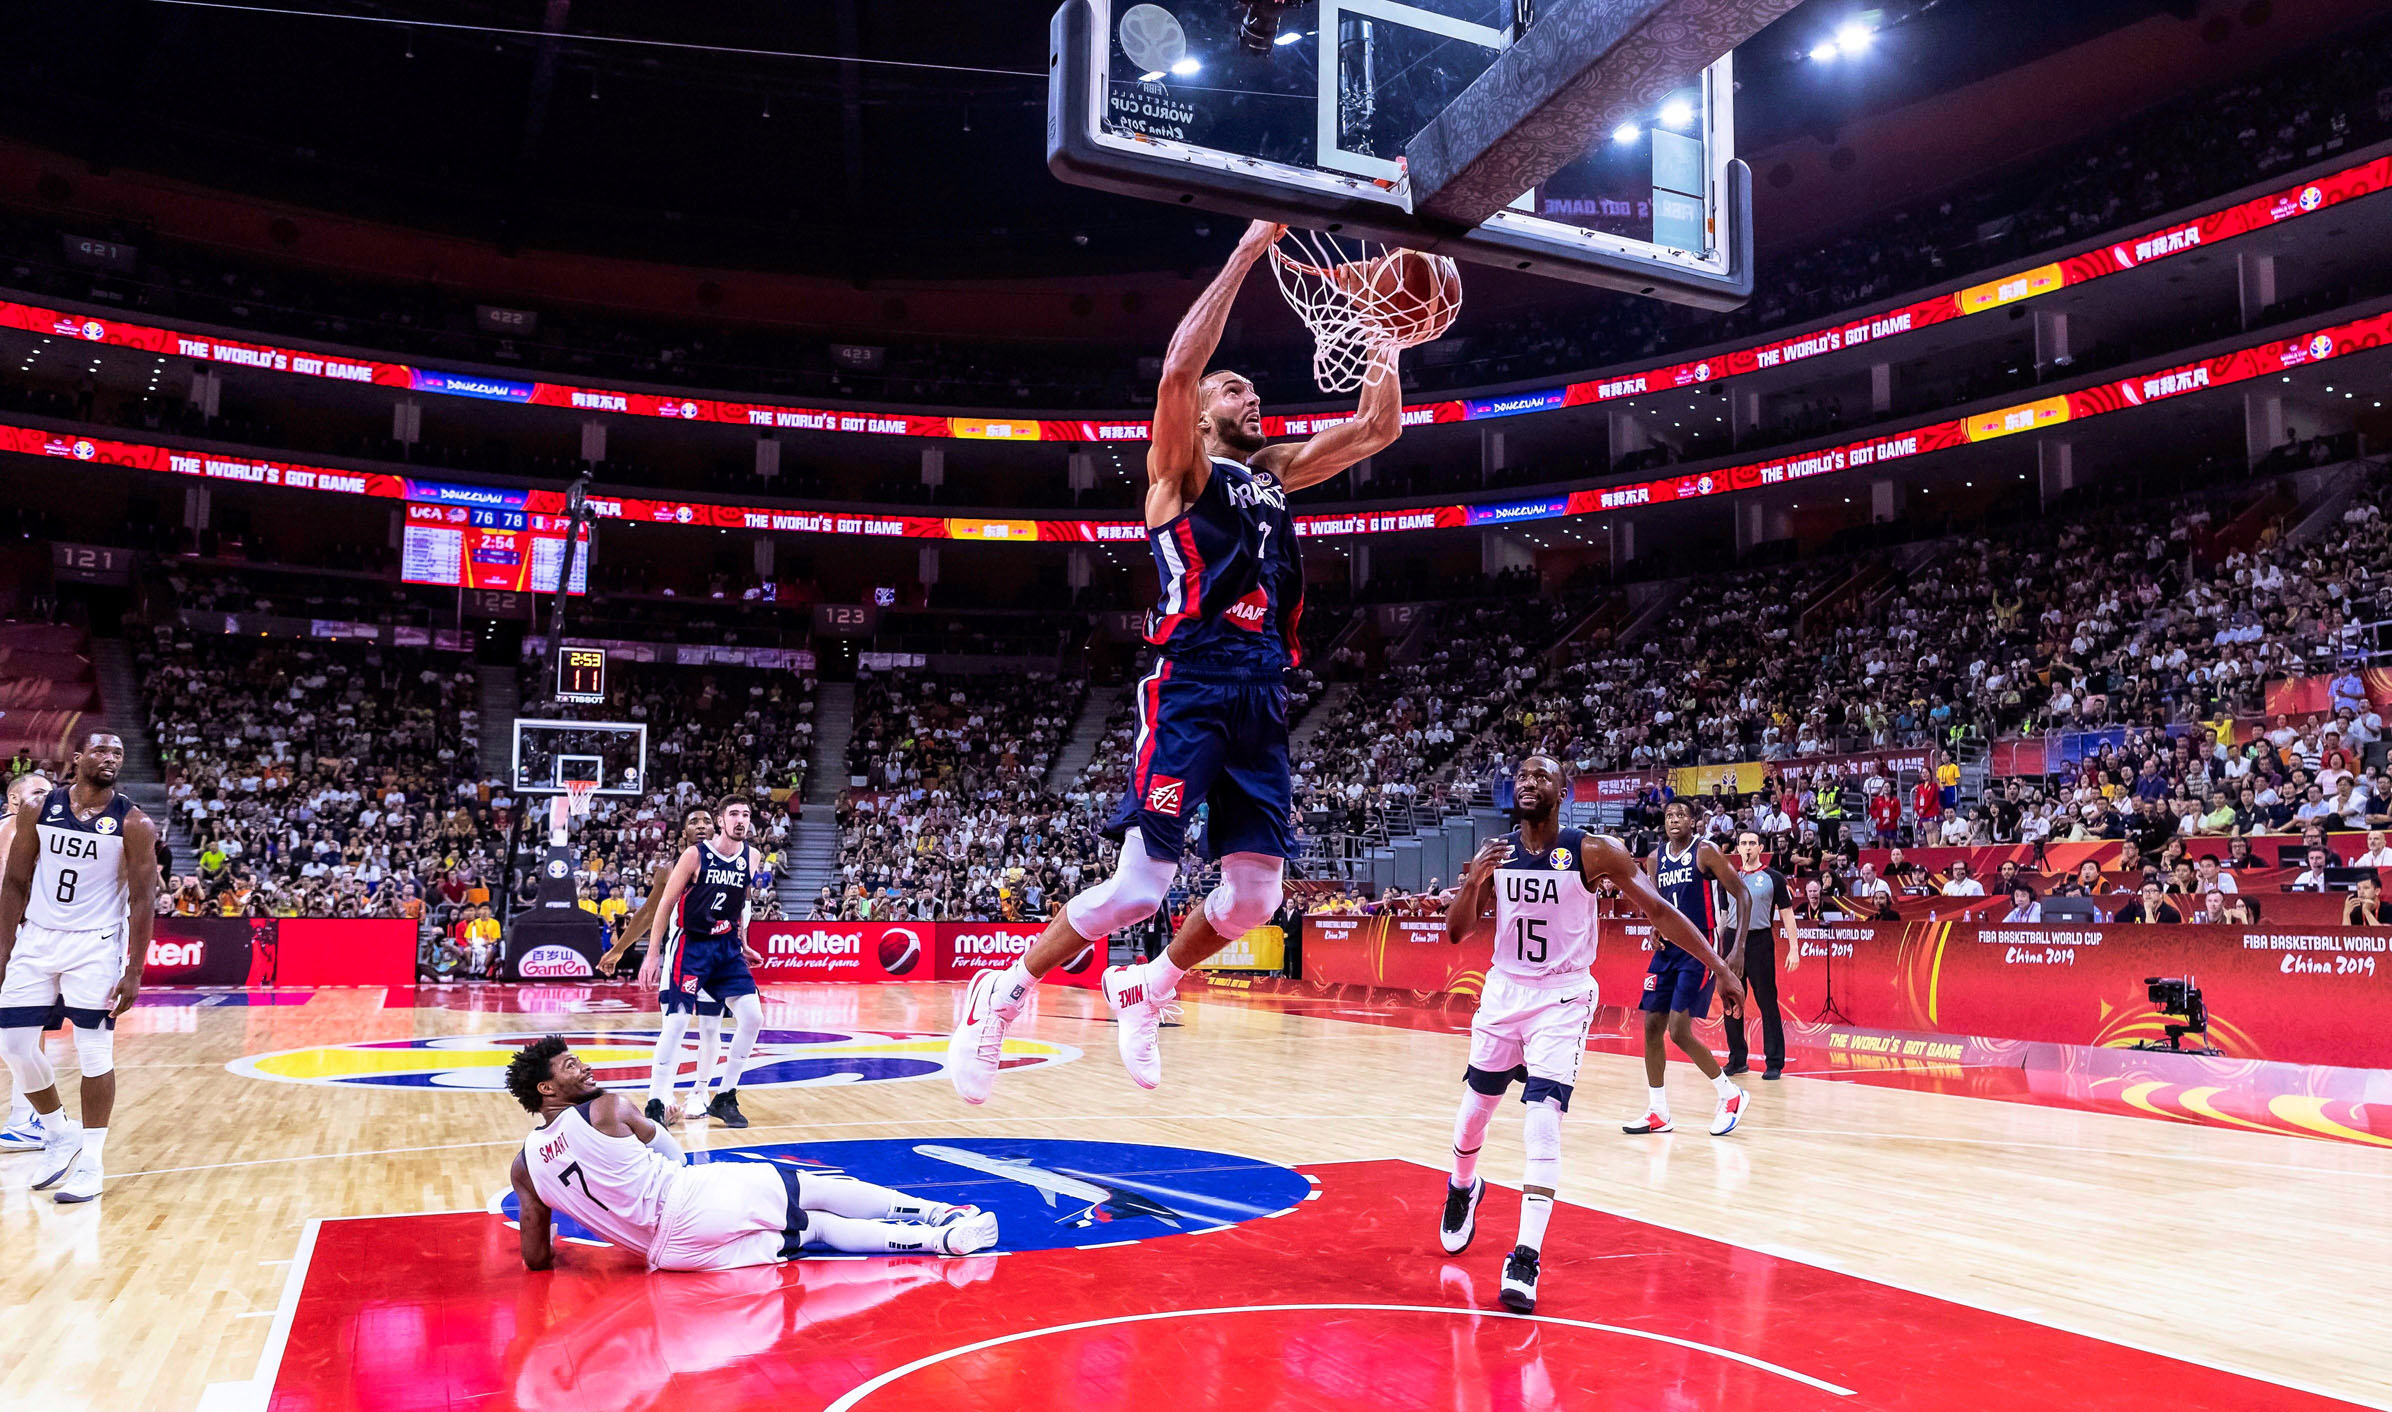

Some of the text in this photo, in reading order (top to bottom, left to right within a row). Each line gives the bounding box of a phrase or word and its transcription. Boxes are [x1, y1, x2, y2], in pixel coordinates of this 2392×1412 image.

[490, 311, 523, 324] 422
[1757, 313, 1911, 368] THE WORLD'S GOT GAME
[178, 339, 373, 382] THE WORLD'S GOT GAME
[842, 349, 871, 360] 423
[748, 410, 906, 434] THE WORLD'S GOT GAME
[1284, 421, 1308, 434] THE
[1760, 437, 1917, 484] THE WORLD'S GOT GAME
[169, 456, 366, 493] THE WORLD'S GOT GAME
[474, 510, 523, 527] 76 78
[744, 513, 903, 535] THE WORLD'S GOT GAME
[1310, 516, 1365, 535] WORLD'S
[1370, 517, 1396, 532] GOT
[1398, 514, 1435, 529] GAME
[1257, 521, 1272, 559] 7
[64, 547, 112, 569] 121
[472, 591, 517, 609] 122
[826, 607, 865, 624] 123
[1226, 601, 1268, 621] MAIF
[1120, 615, 1141, 630] 12
[570, 652, 601, 667] 2:53
[574, 669, 598, 691] 11
[569, 695, 605, 704] TISSOT
[50, 834, 98, 860] USA
[56, 868, 79, 903] 8
[705, 869, 746, 888] FRANCE
[1658, 867, 1693, 888] FRANCE
[1506, 877, 1559, 904] USA
[711, 892, 727, 911] 12
[711, 920, 731, 935] MAIF
[1835, 929, 1859, 940] WORLD
[1860, 929, 1875, 941] CUP
[1978, 930, 2103, 945] FIBA BASKETBALL WORLD CUP
[768, 930, 860, 955] molten
[1516, 917, 1548, 963] 15
[1831, 942, 1854, 959] 2019
[2243, 934, 2268, 949] FIBA
[2270, 935, 2342, 951] BASKETBALL
[2343, 936, 2386, 952] WORLD
[532, 950, 573, 961] 百岁山
[764, 956, 860, 971] For the real game
[952, 956, 970, 968] For
[970, 956, 987, 967] the
[2005, 946, 2075, 967] China 2019
[2280, 953, 2376, 977] China 2019
[1118, 983, 1144, 1009] NIKE
[1829, 1033, 1964, 1060] THE WORLD'S GOT GAME
[539, 1132, 570, 1163] SMART
[557, 1160, 609, 1212] 7
